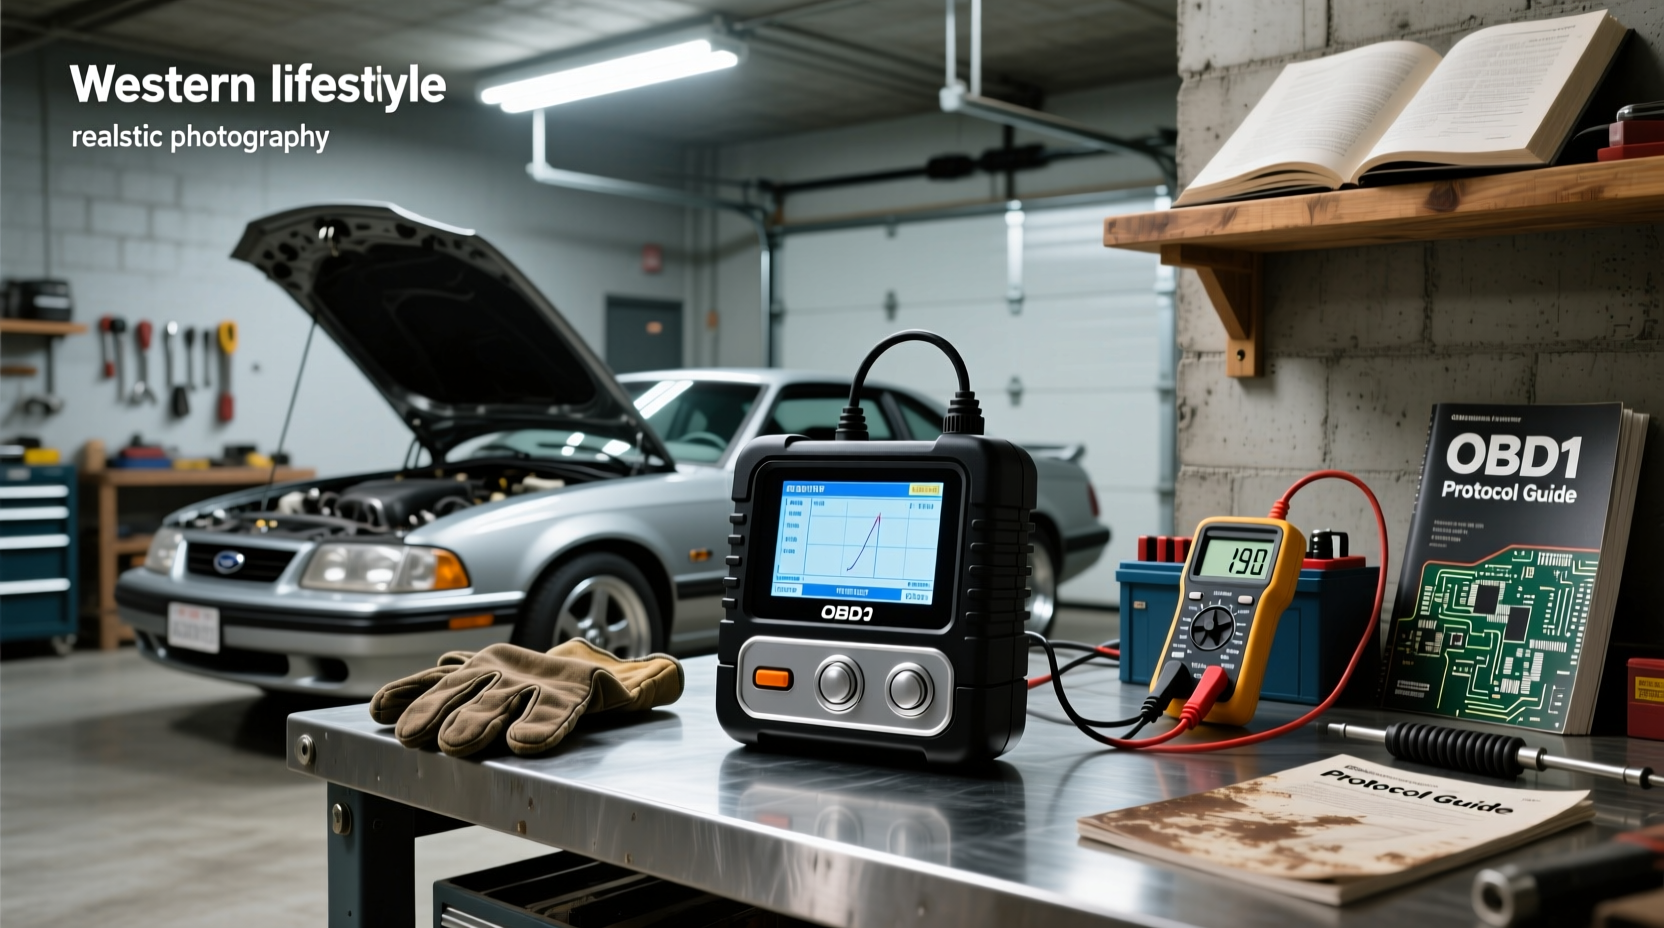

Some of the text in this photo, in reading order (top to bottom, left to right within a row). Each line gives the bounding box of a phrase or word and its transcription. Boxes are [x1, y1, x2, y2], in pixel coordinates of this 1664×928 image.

[1446, 432, 1583, 479] OBD1
[1441, 480, 1578, 504] Protocol Guide
[1228, 547, 1268, 576] 190
[1320, 769, 1433, 800] Protocol
[1433, 794, 1514, 816] Guide
